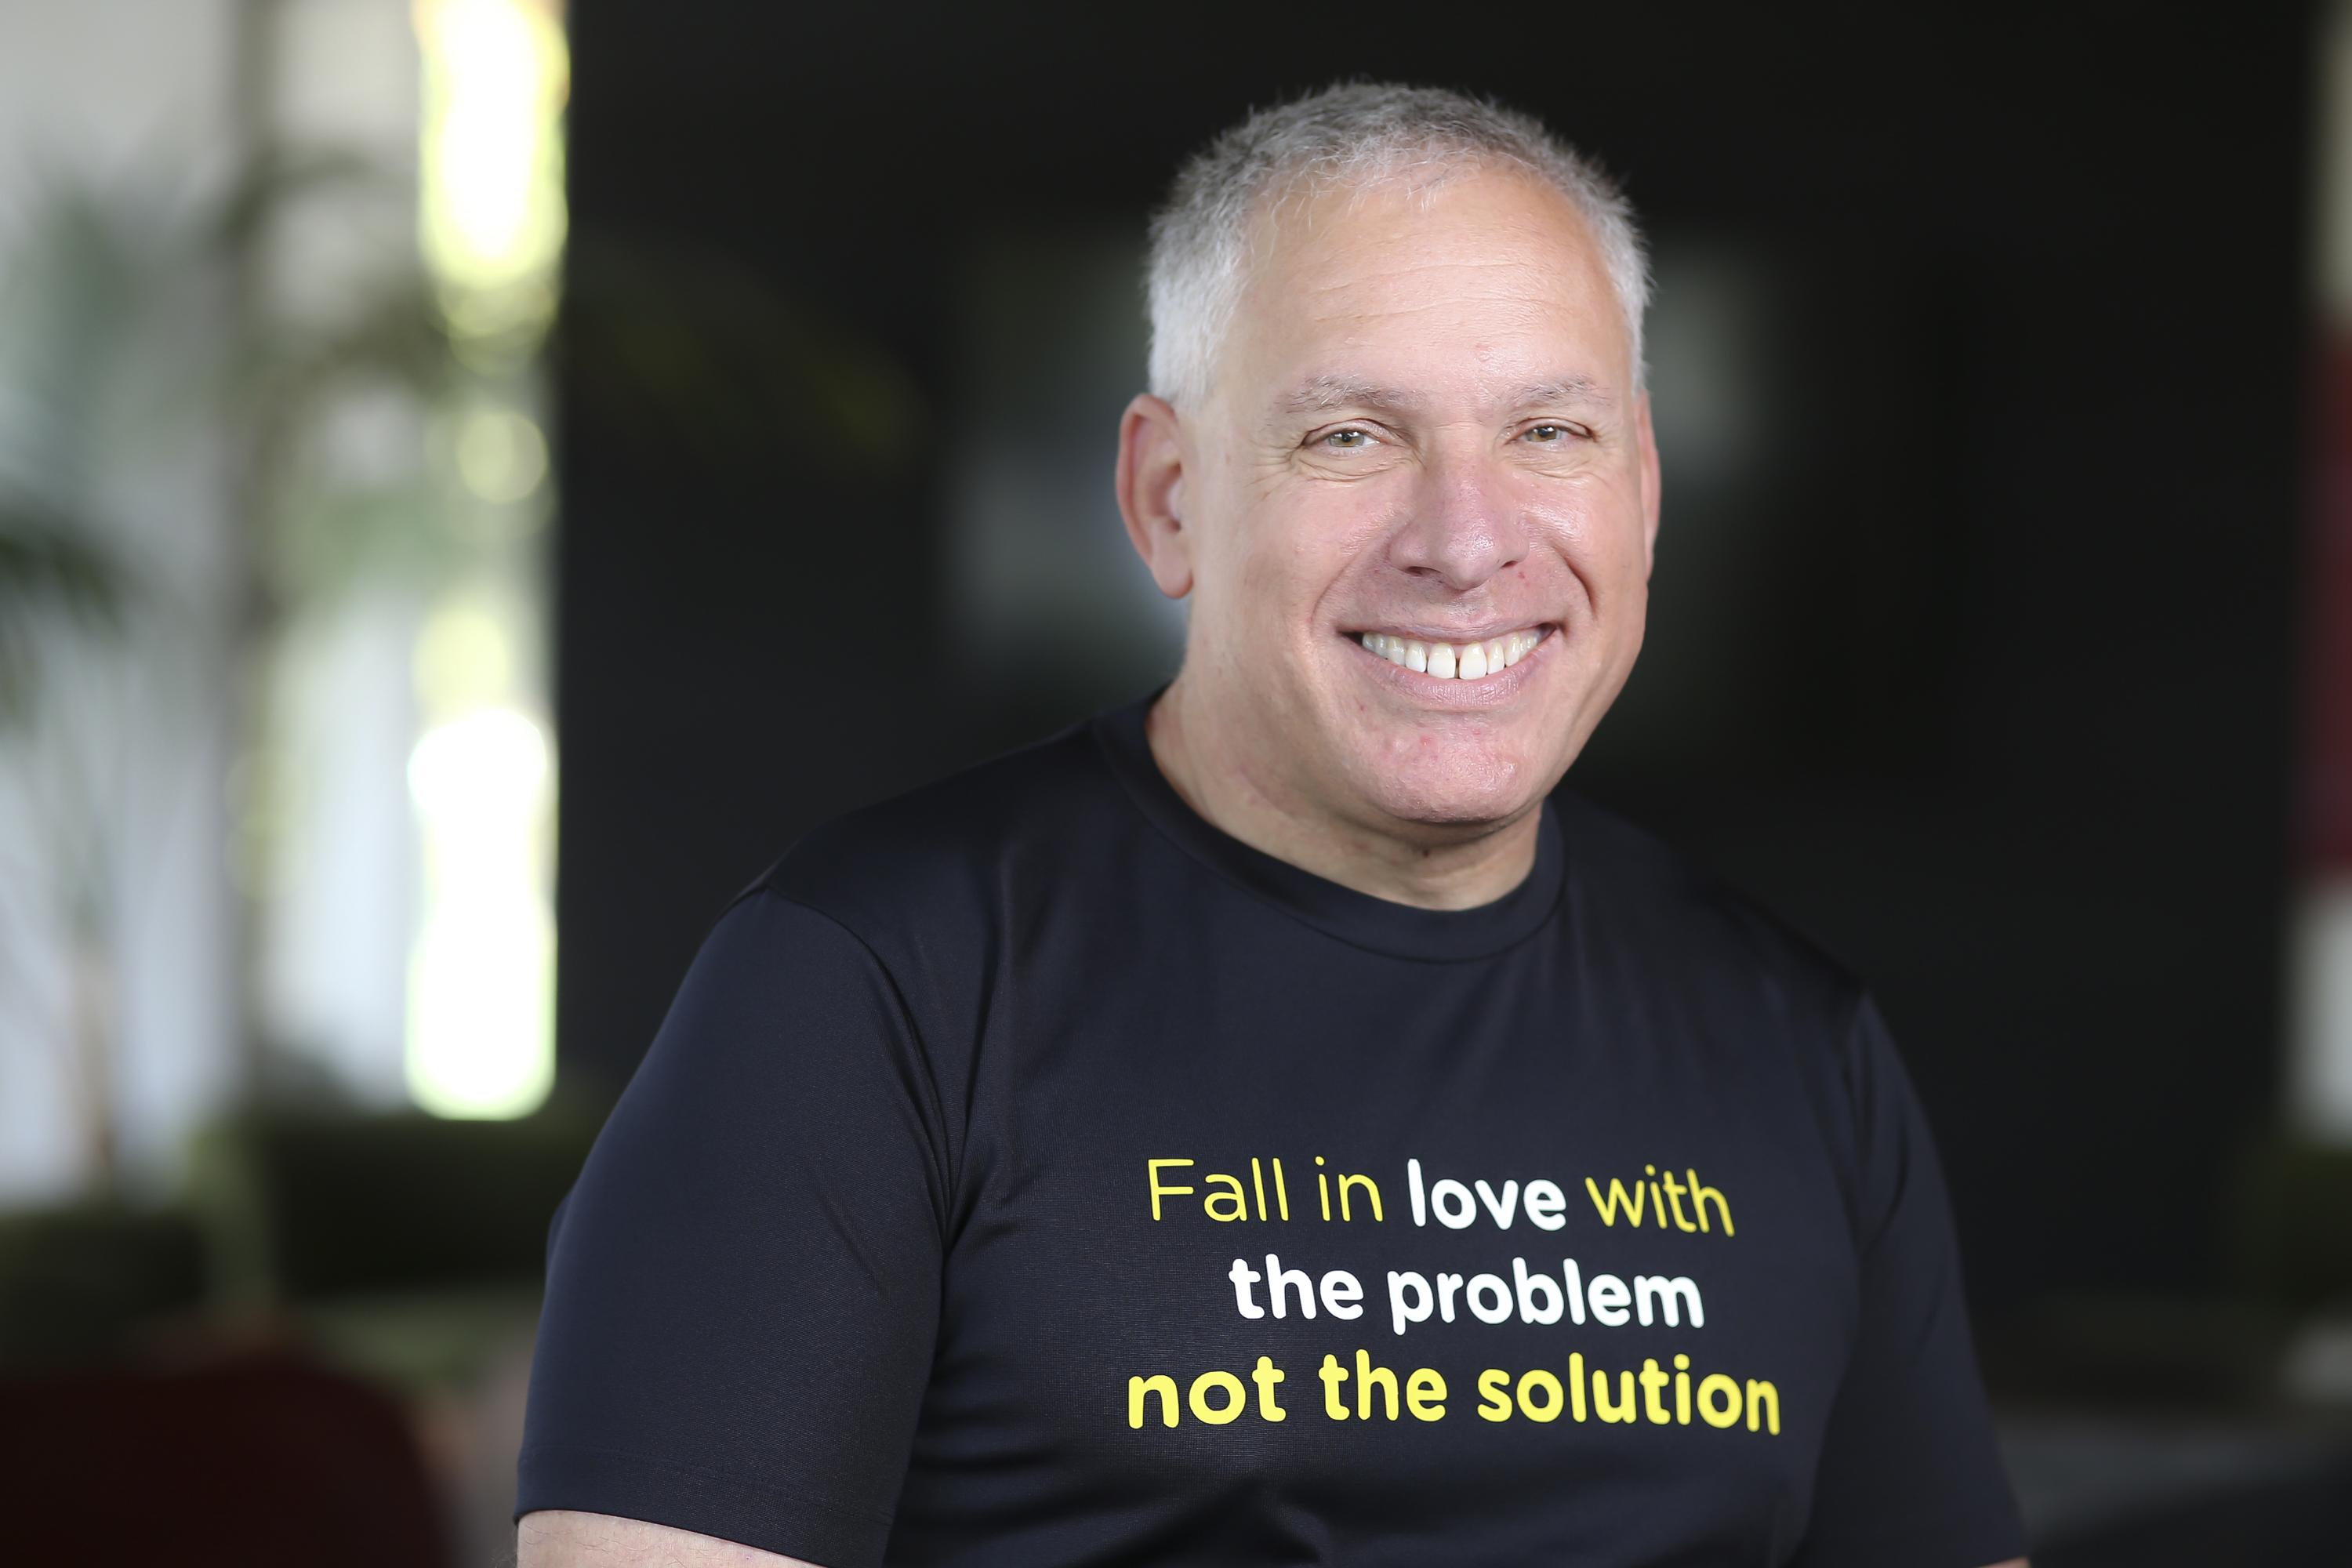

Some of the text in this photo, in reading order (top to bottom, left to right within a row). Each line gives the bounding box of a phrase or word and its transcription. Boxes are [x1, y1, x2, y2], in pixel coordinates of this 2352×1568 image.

[1148, 1156, 1735, 1237] Fall in love with
[1228, 1253, 1705, 1336] the problem
[1127, 1348, 1780, 1436] not the solution
